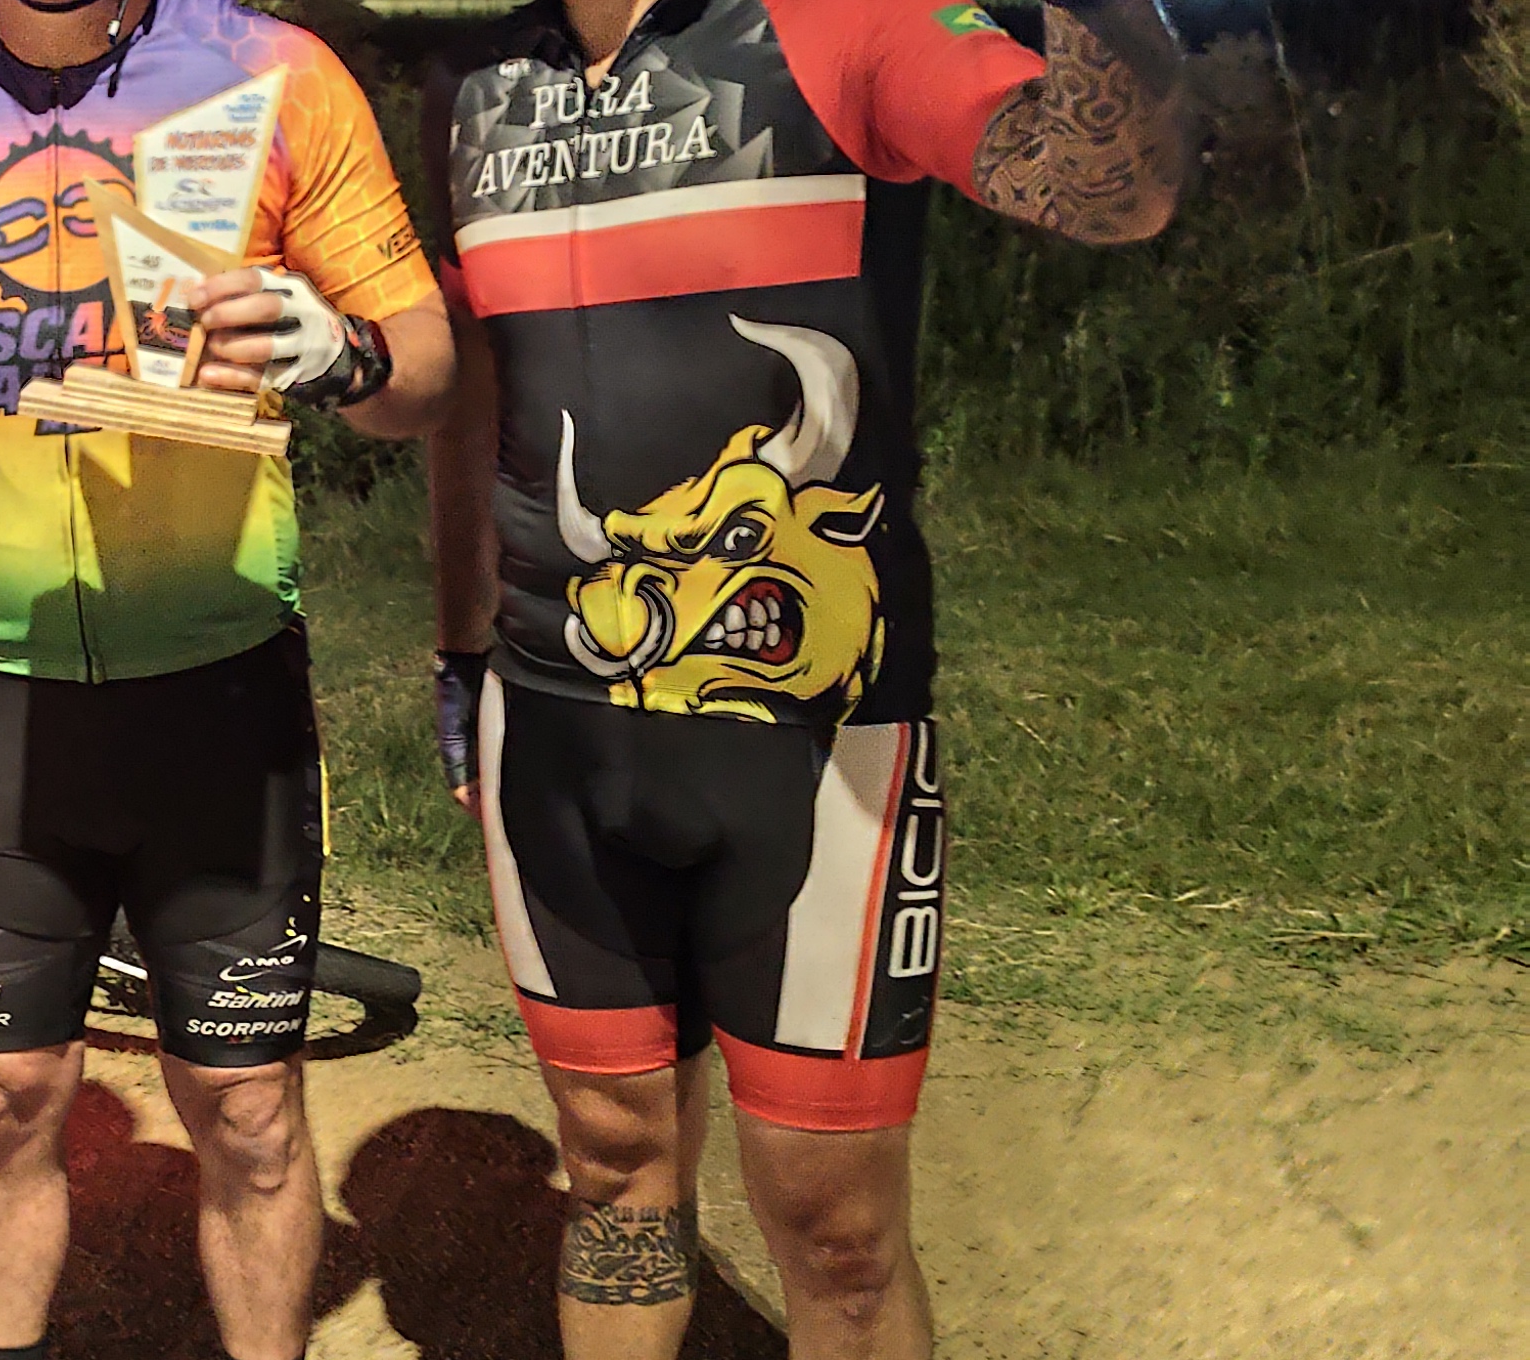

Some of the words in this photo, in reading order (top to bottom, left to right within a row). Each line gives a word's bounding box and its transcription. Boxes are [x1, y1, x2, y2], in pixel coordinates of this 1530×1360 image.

[529, 70, 655, 130] PURA
[473, 116, 717, 198] AVENTURA
[207, 986, 305, 1009] Santini
[186, 1018, 303, 1037] SCORPION
